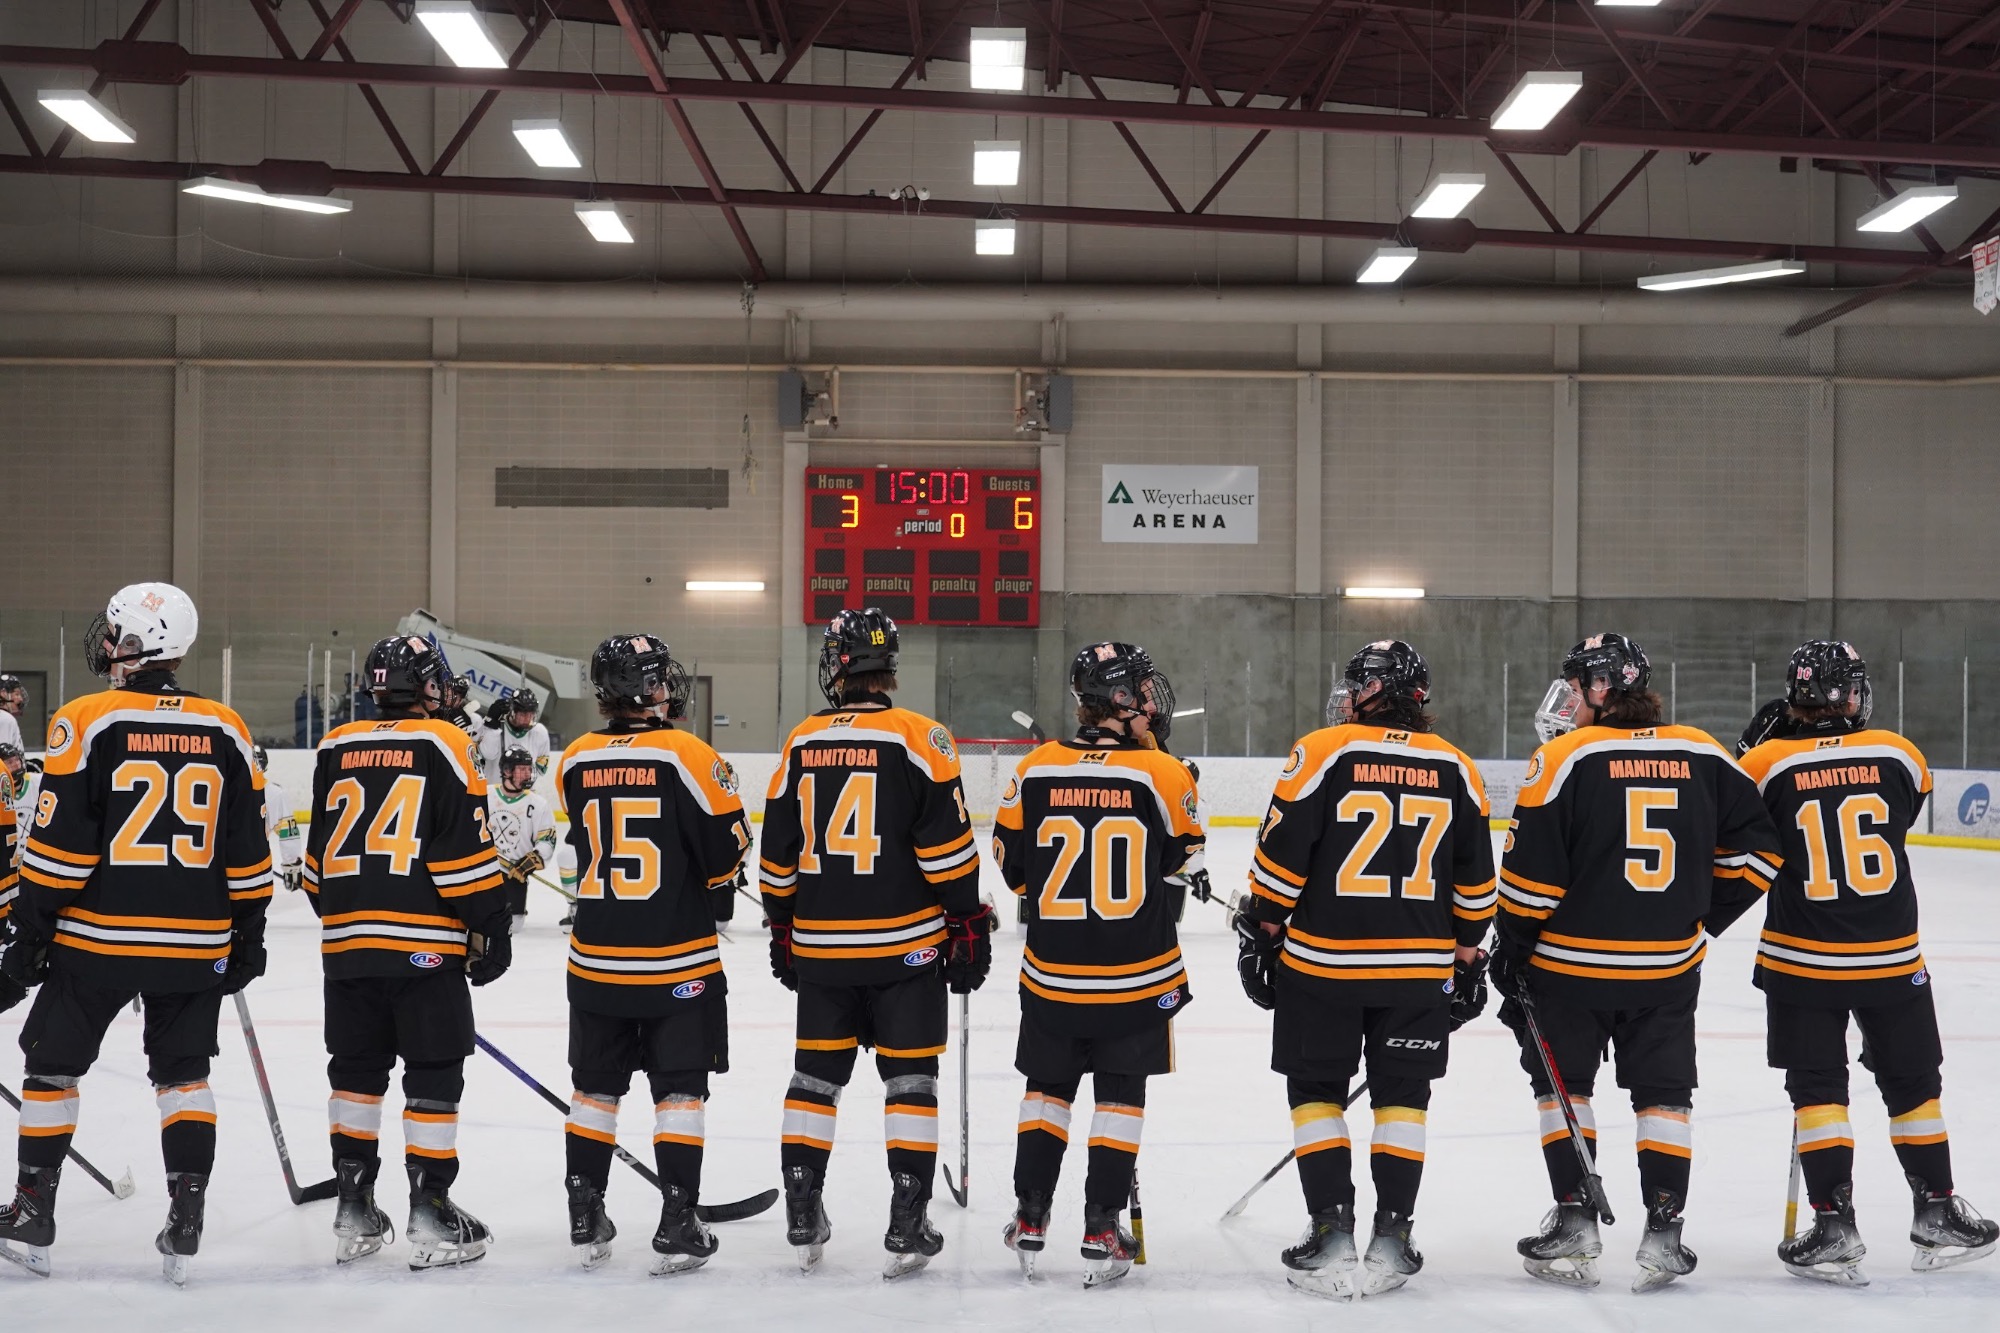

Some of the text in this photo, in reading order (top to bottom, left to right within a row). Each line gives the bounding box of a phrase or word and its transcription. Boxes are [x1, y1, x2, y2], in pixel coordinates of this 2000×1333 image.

[818, 475, 853, 489] Home
[891, 472, 969, 504] 15:00
[989, 476, 1031, 491] Guests
[1142, 489, 1255, 509] Weyerhaeuser
[841, 495, 859, 528] 3
[1014, 497, 1033, 530] 6
[1133, 513, 1226, 529] ARENA
[904, 519, 942, 534] period
[950, 513, 965, 537] 0
[811, 577, 848, 591] player
[866, 577, 910, 592] penalty
[932, 578, 976, 593] penalty
[995, 578, 1033, 593] player
[870, 630, 885, 645] 18
[373, 668, 387, 683] 77
[421, 663, 435, 675] CCM
[642, 662, 659, 671] CCM
[1105, 670, 1126, 680] CCM
[464, 668, 514, 699] ALTE
[127, 732, 213, 755] MANITOBA
[341, 750, 413, 770] MANITOBA
[801, 748, 878, 767] MANITOBA
[1083, 752, 1108, 761] KJ
[582, 767, 656, 788] MANITOBA
[1354, 763, 1439, 788] MANITOBA
[1609, 760, 1691, 779] MANITOBA
[1794, 765, 1881, 791] MANITOBA
[1050, 788, 1132, 809] MANITOBA
[109, 760, 224, 869] 29
[526, 804, 535, 819] C
[323, 774, 427, 879] 24
[797, 772, 882, 875] 14
[577, 797, 661, 900] 15
[1336, 790, 1453, 901] 27
[1624, 787, 1679, 892] 5
[1795, 793, 1897, 901] 16
[1037, 815, 1148, 920] 20
[1386, 1037, 1441, 1051] CCM
[272, 1120, 289, 1161] CCM
